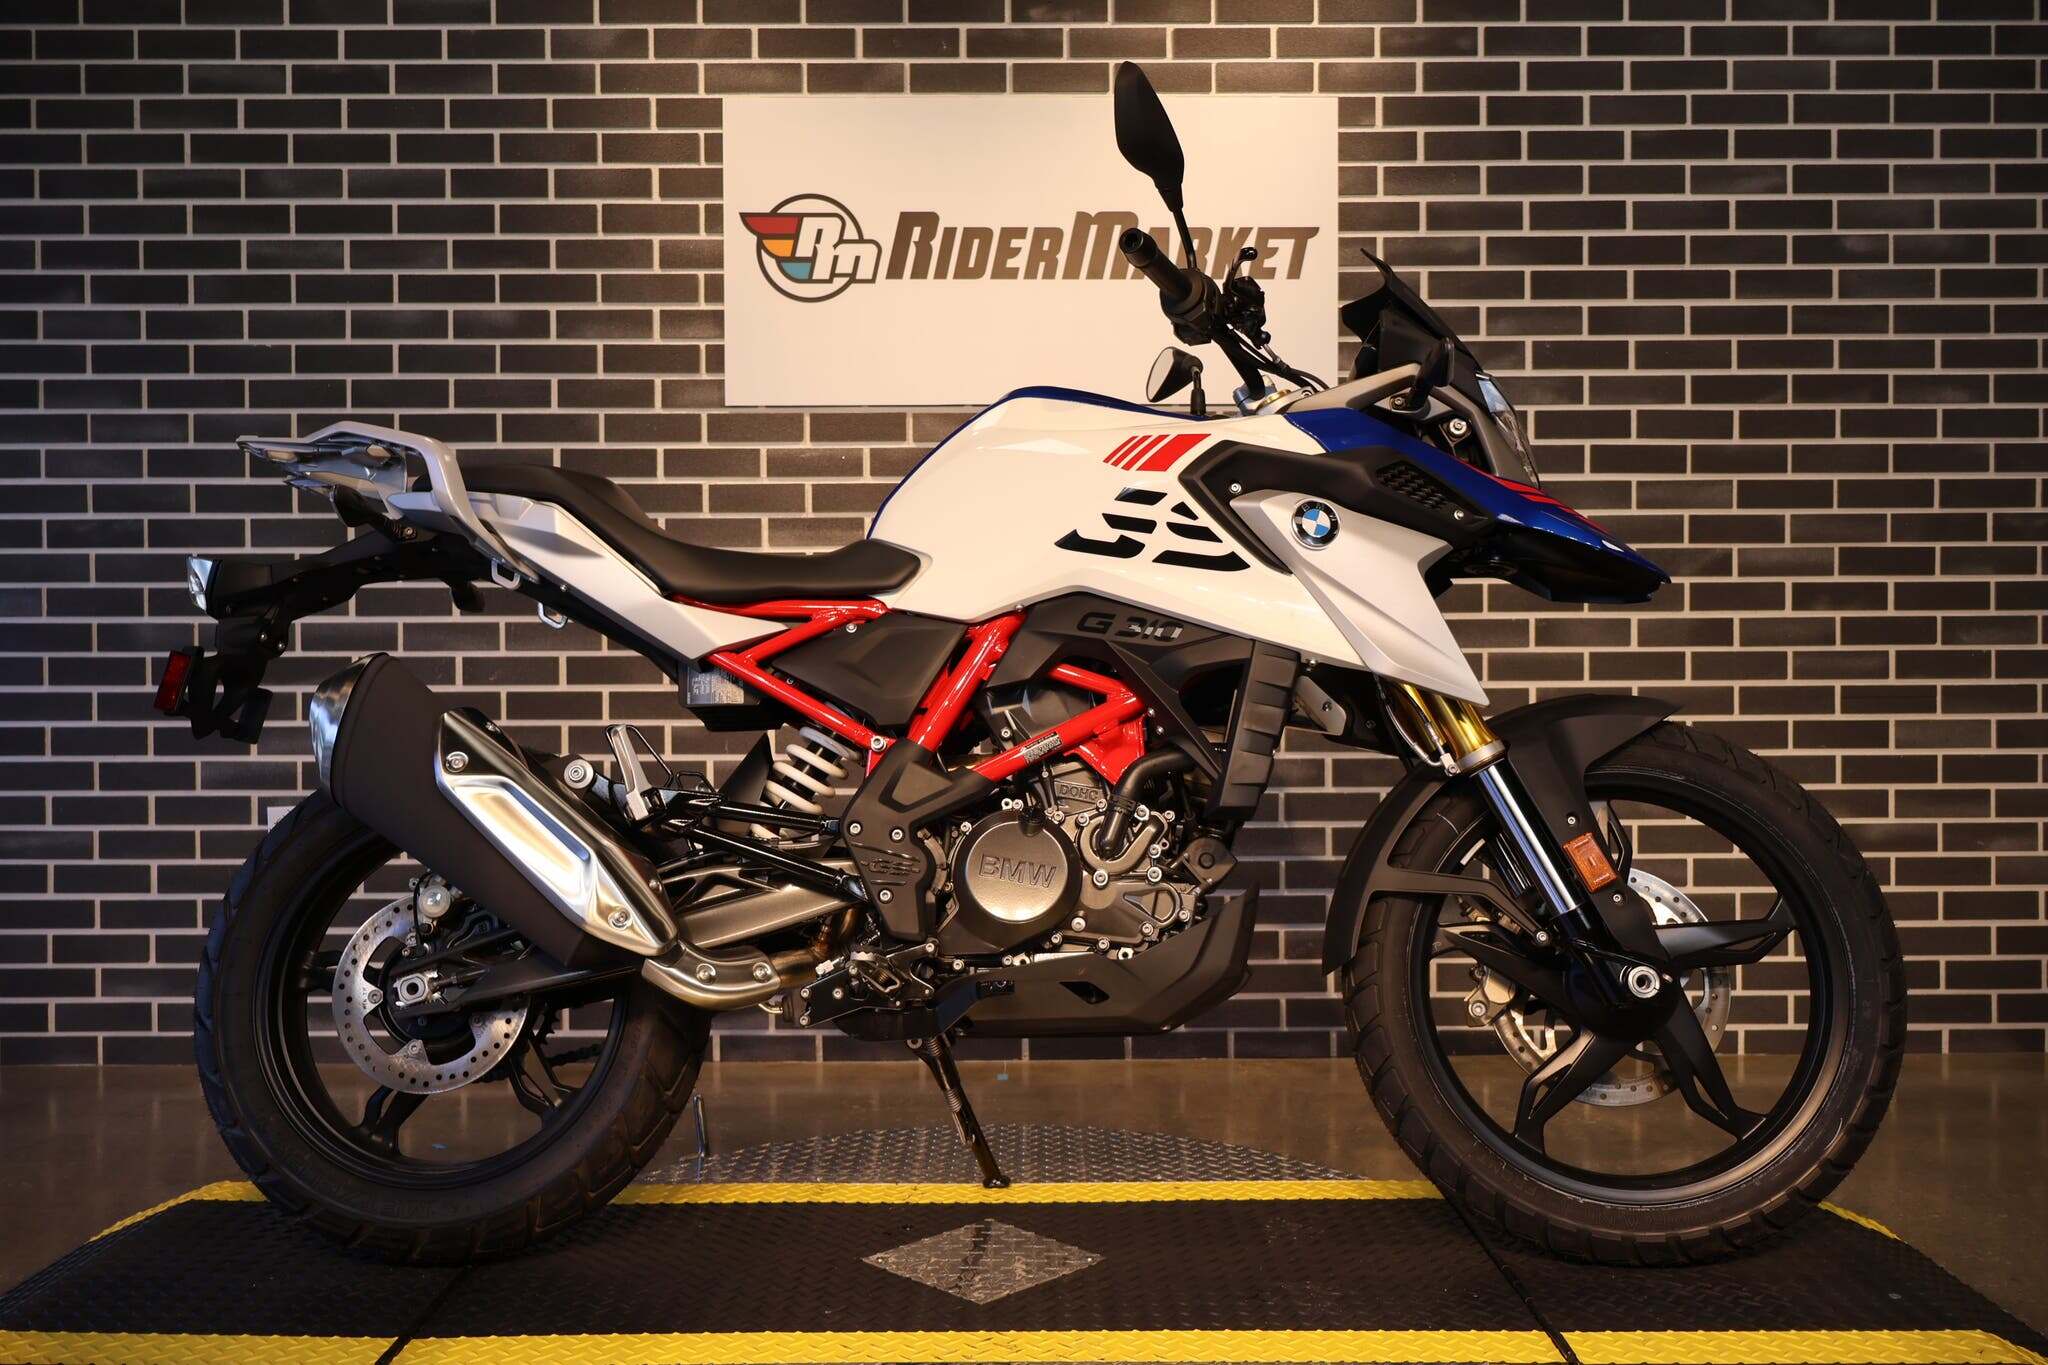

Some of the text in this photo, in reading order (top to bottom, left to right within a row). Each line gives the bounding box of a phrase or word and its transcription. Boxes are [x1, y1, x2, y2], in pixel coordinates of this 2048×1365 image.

[1077, 611, 1185, 642] G 310
[1059, 784, 1099, 801] DOHC
[978, 853, 1057, 889] BMW
